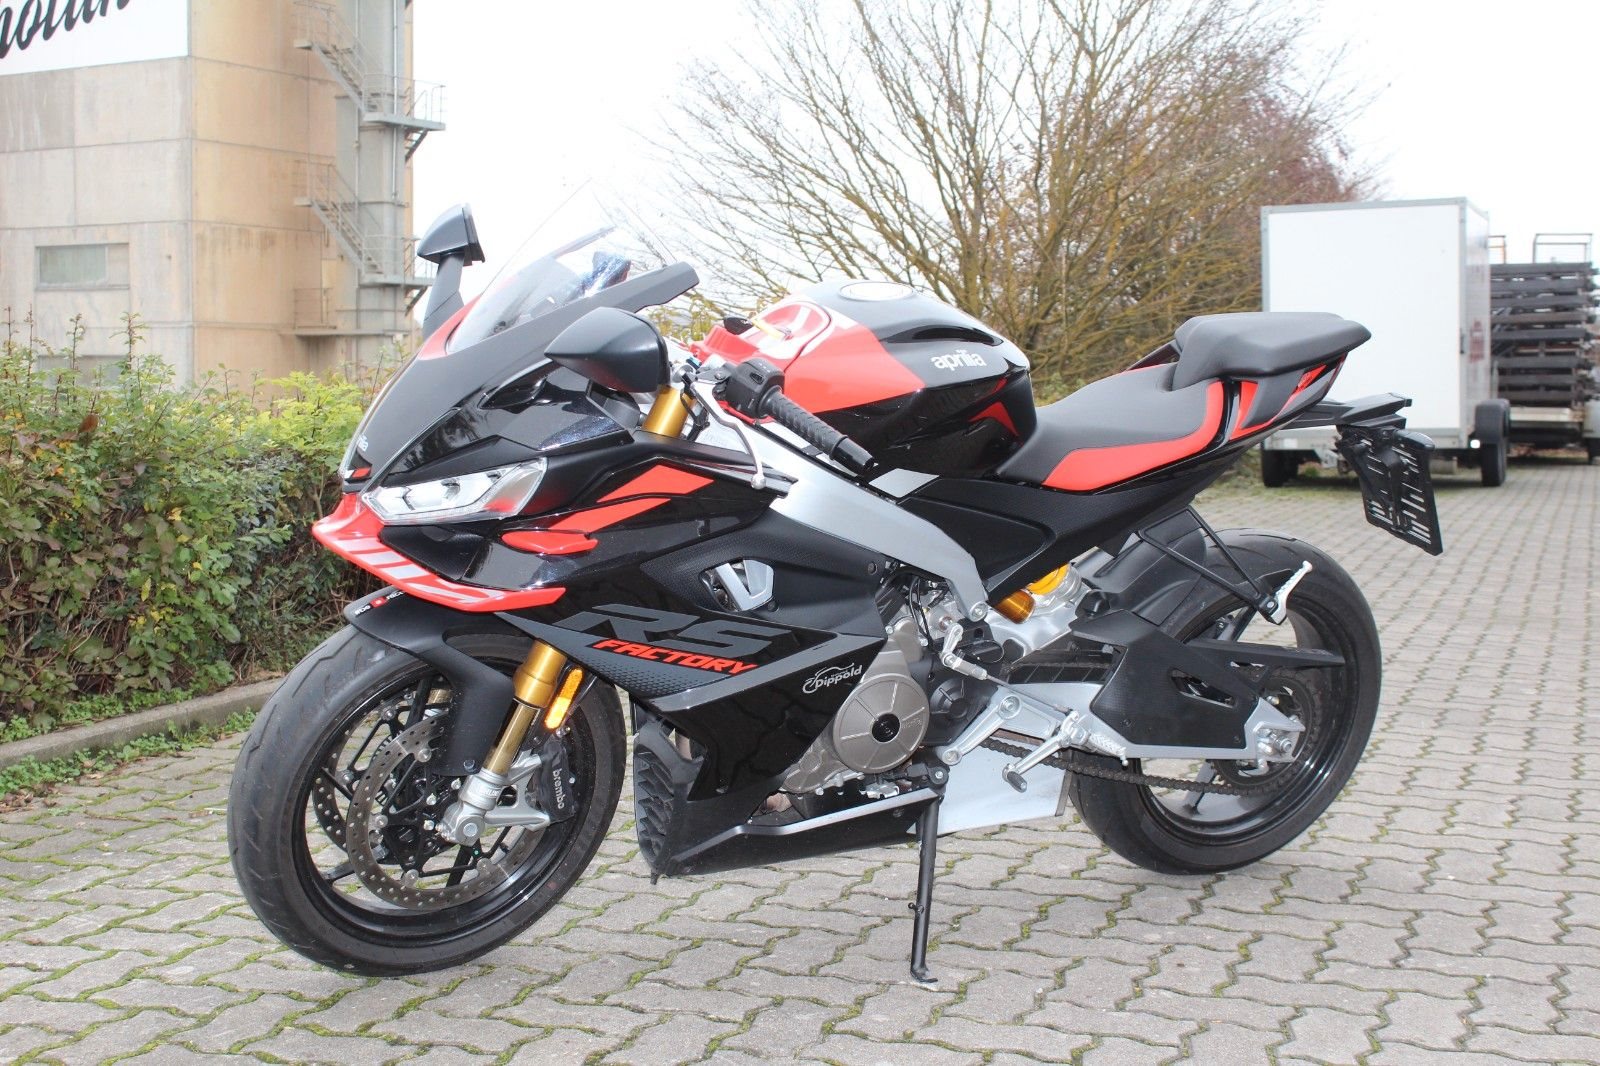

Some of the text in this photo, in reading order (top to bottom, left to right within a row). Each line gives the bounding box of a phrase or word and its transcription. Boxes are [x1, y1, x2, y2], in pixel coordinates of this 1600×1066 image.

[931, 350, 987, 371] aprilia
[552, 604, 793, 659] RS
[592, 638, 759, 675] FACTORY
[815, 664, 863, 689] Dippold
[552, 768, 566, 810] brembo
